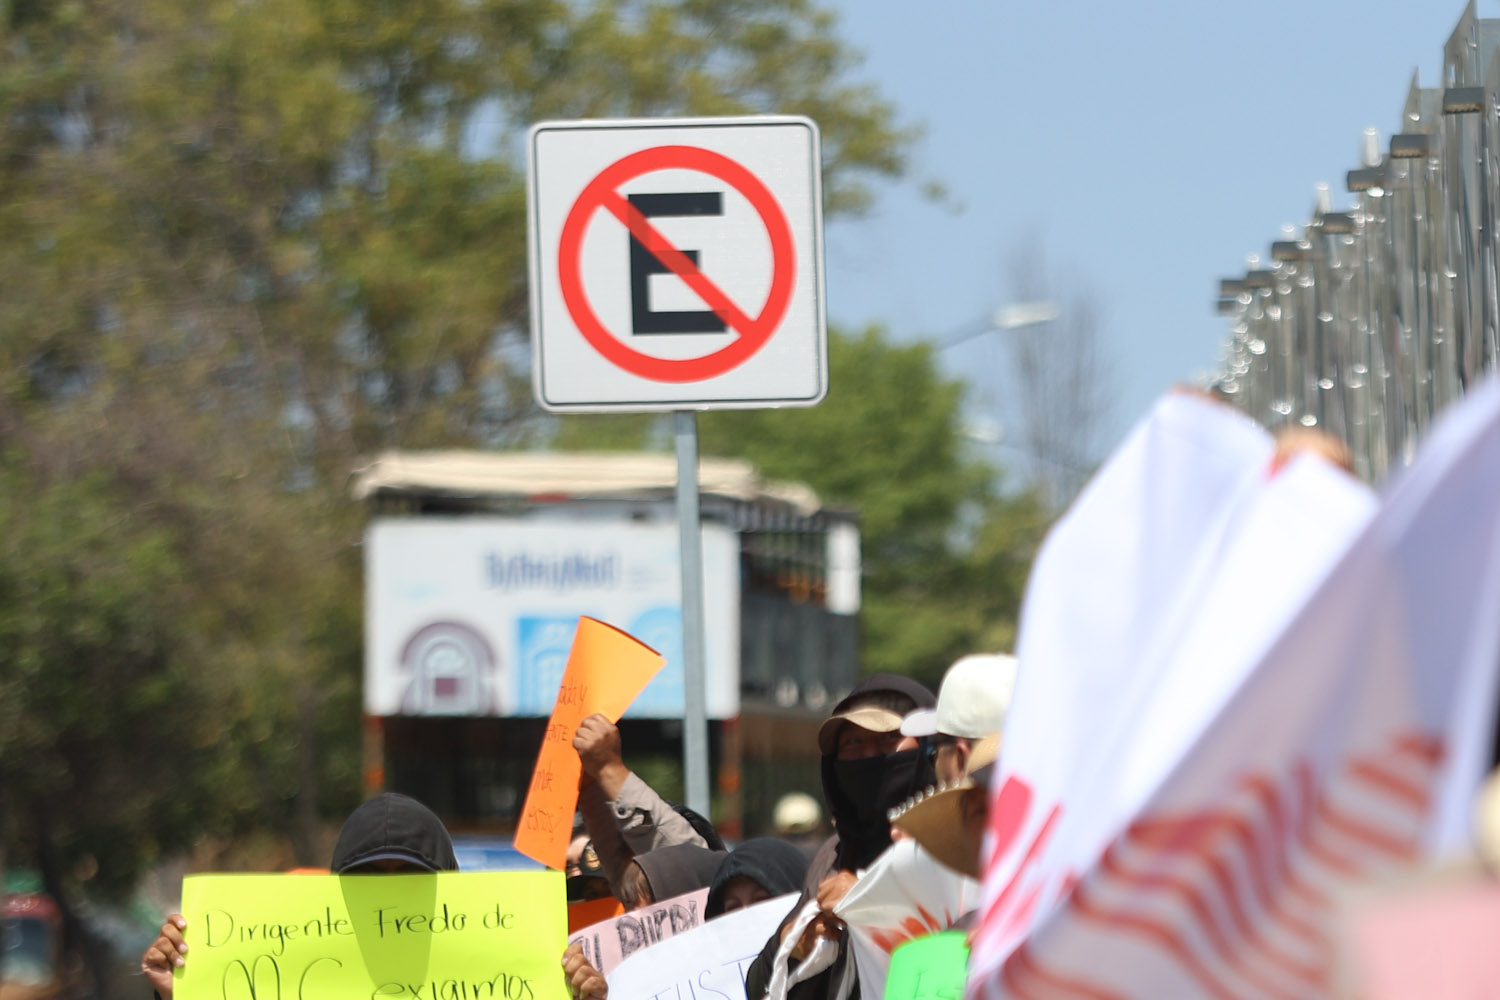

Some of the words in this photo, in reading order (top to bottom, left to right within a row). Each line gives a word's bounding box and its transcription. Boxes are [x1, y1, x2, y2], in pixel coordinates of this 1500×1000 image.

[628, 192, 729, 335] E
[206, 906, 356, 957] Dirigente
[483, 903, 515, 930] de
